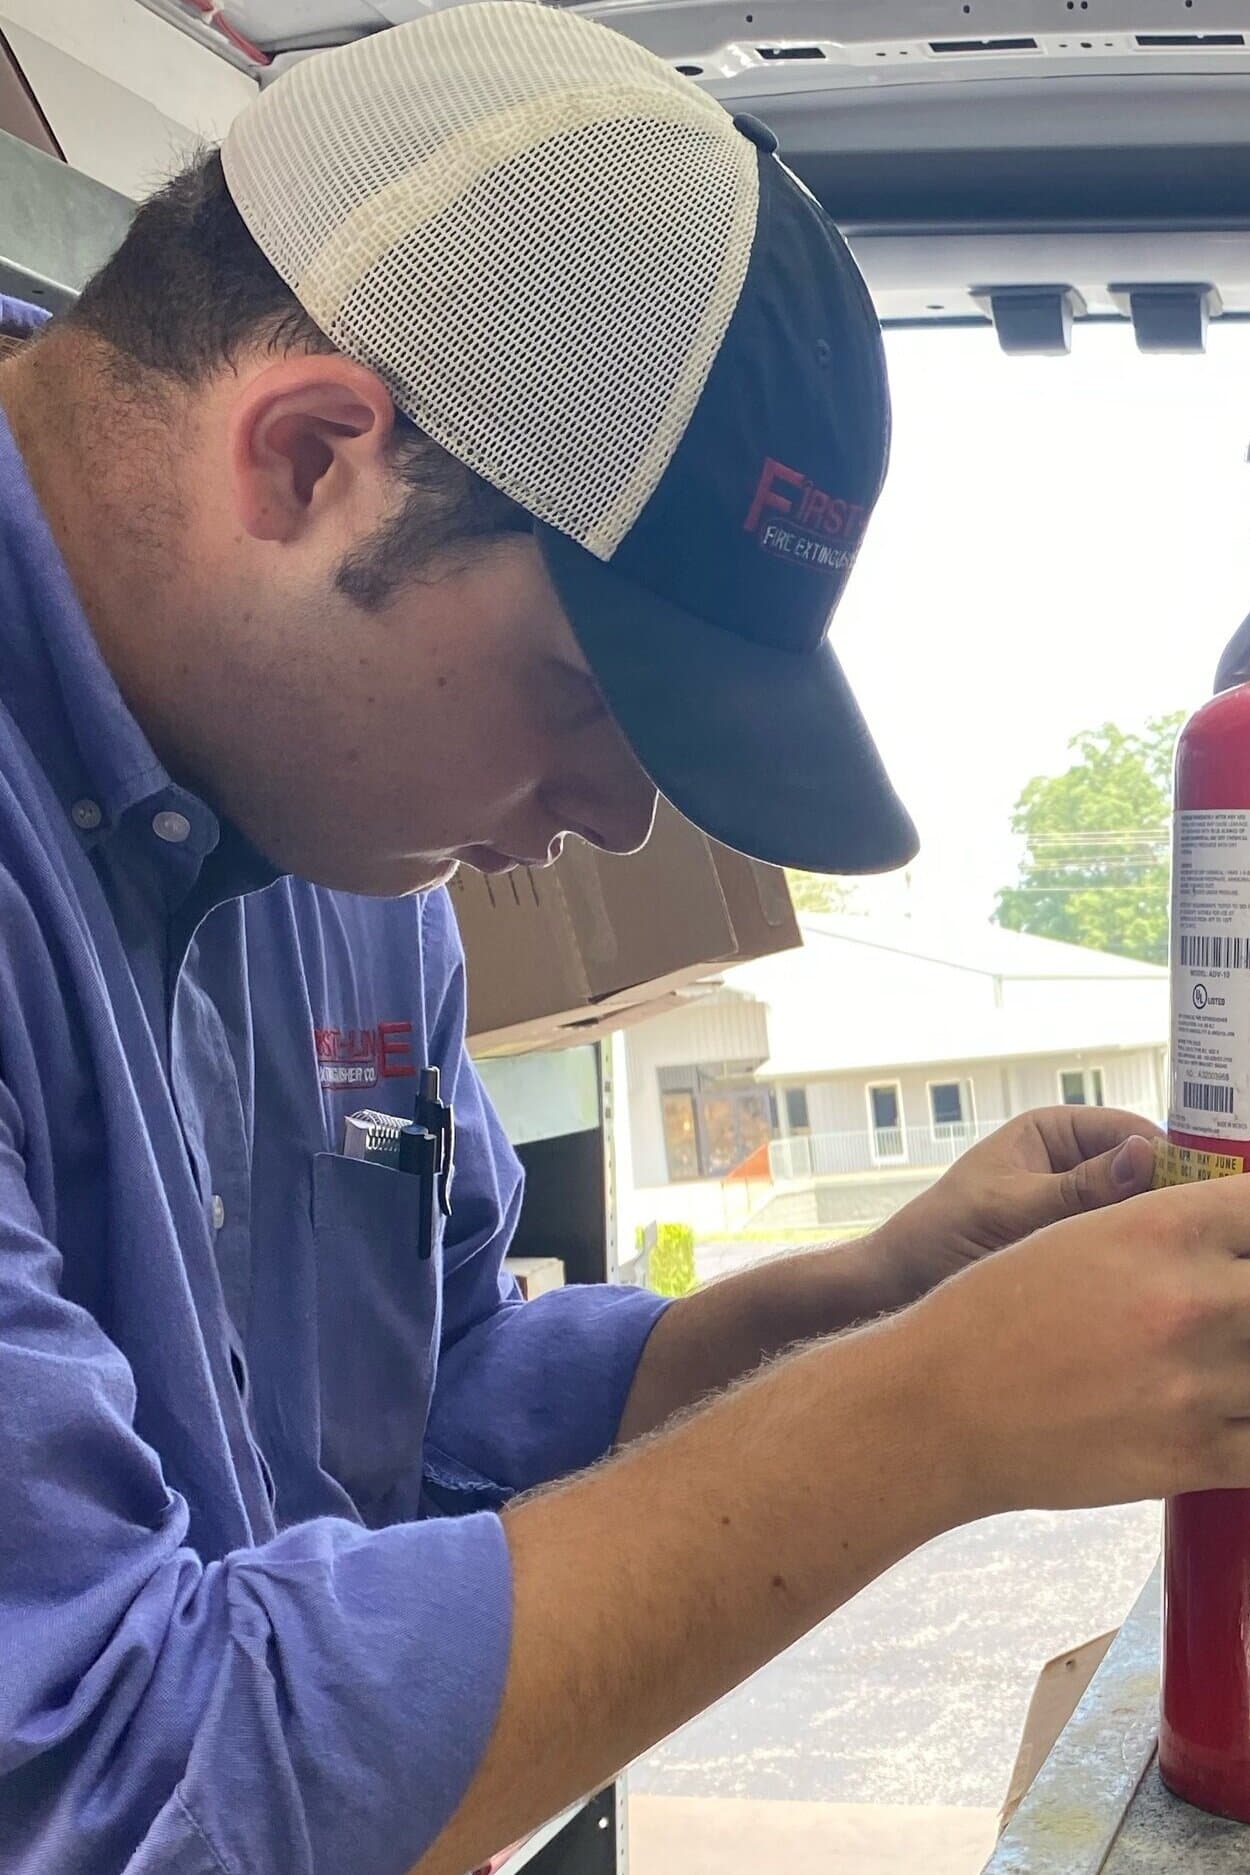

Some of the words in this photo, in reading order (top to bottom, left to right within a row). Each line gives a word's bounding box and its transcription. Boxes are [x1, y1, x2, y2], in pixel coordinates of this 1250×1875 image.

[744, 456, 867, 536] FIRST
[763, 525, 796, 553] FIRE
[1215, 1156, 1237, 1170] JUNE
